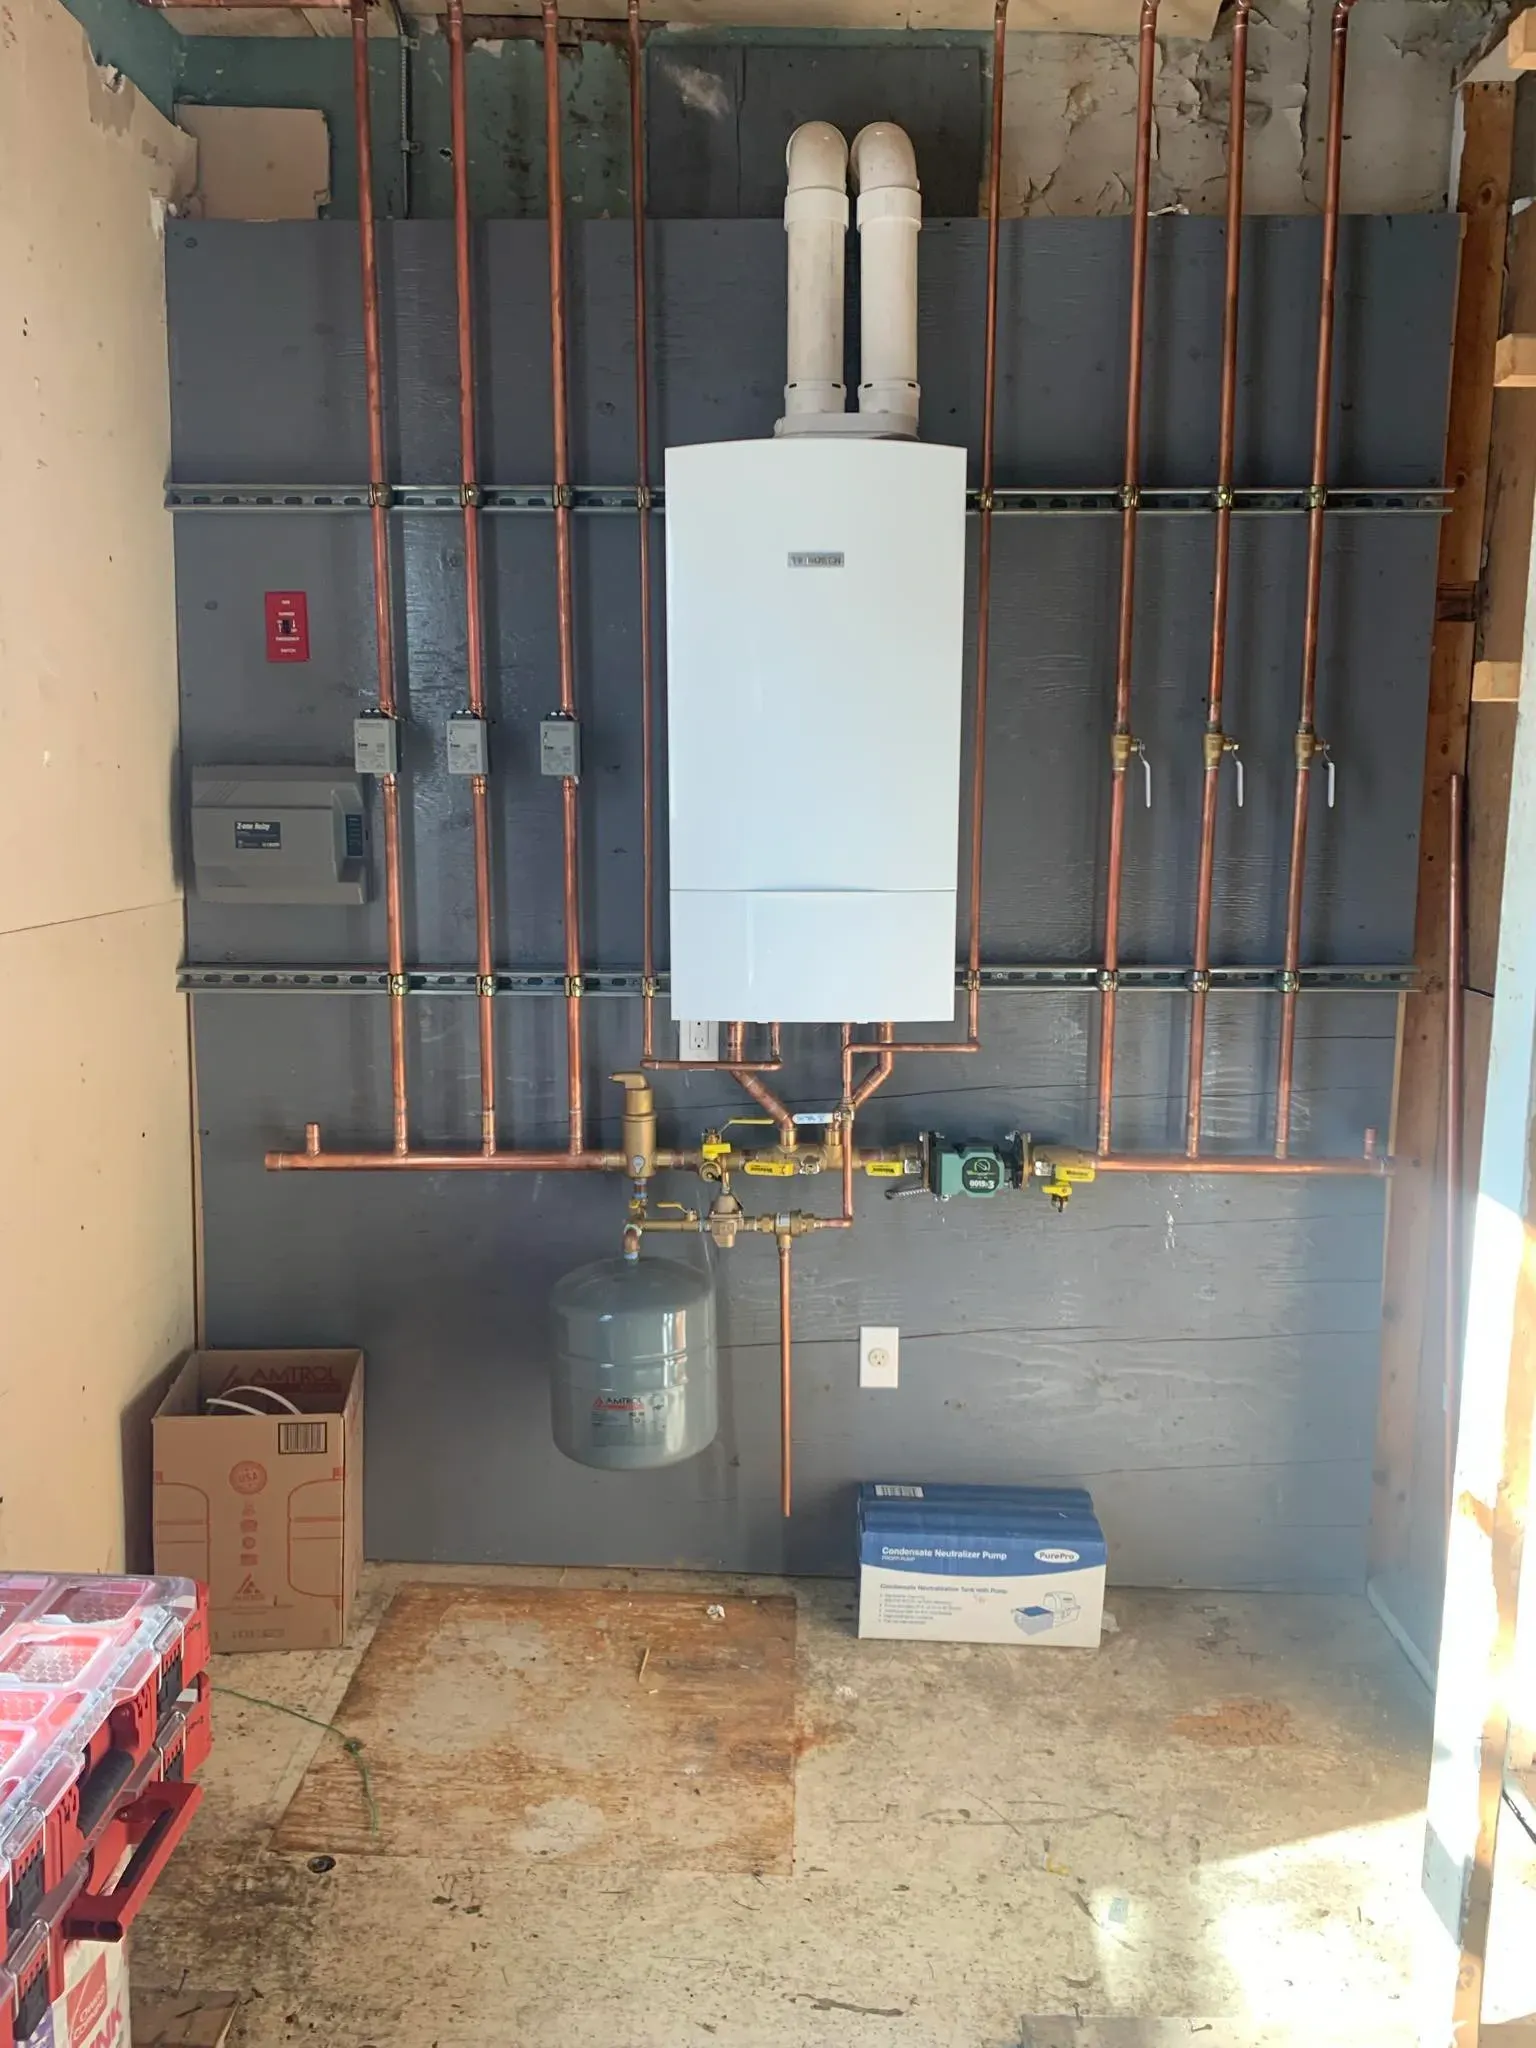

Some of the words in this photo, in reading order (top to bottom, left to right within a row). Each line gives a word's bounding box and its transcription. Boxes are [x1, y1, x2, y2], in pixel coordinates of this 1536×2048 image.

[881, 1546, 933, 1557] Condensate
[934, 1548, 981, 1559] Neutralizer
[982, 1550, 1008, 1561] Pump
[1039, 1551, 1075, 1560] PurePro
